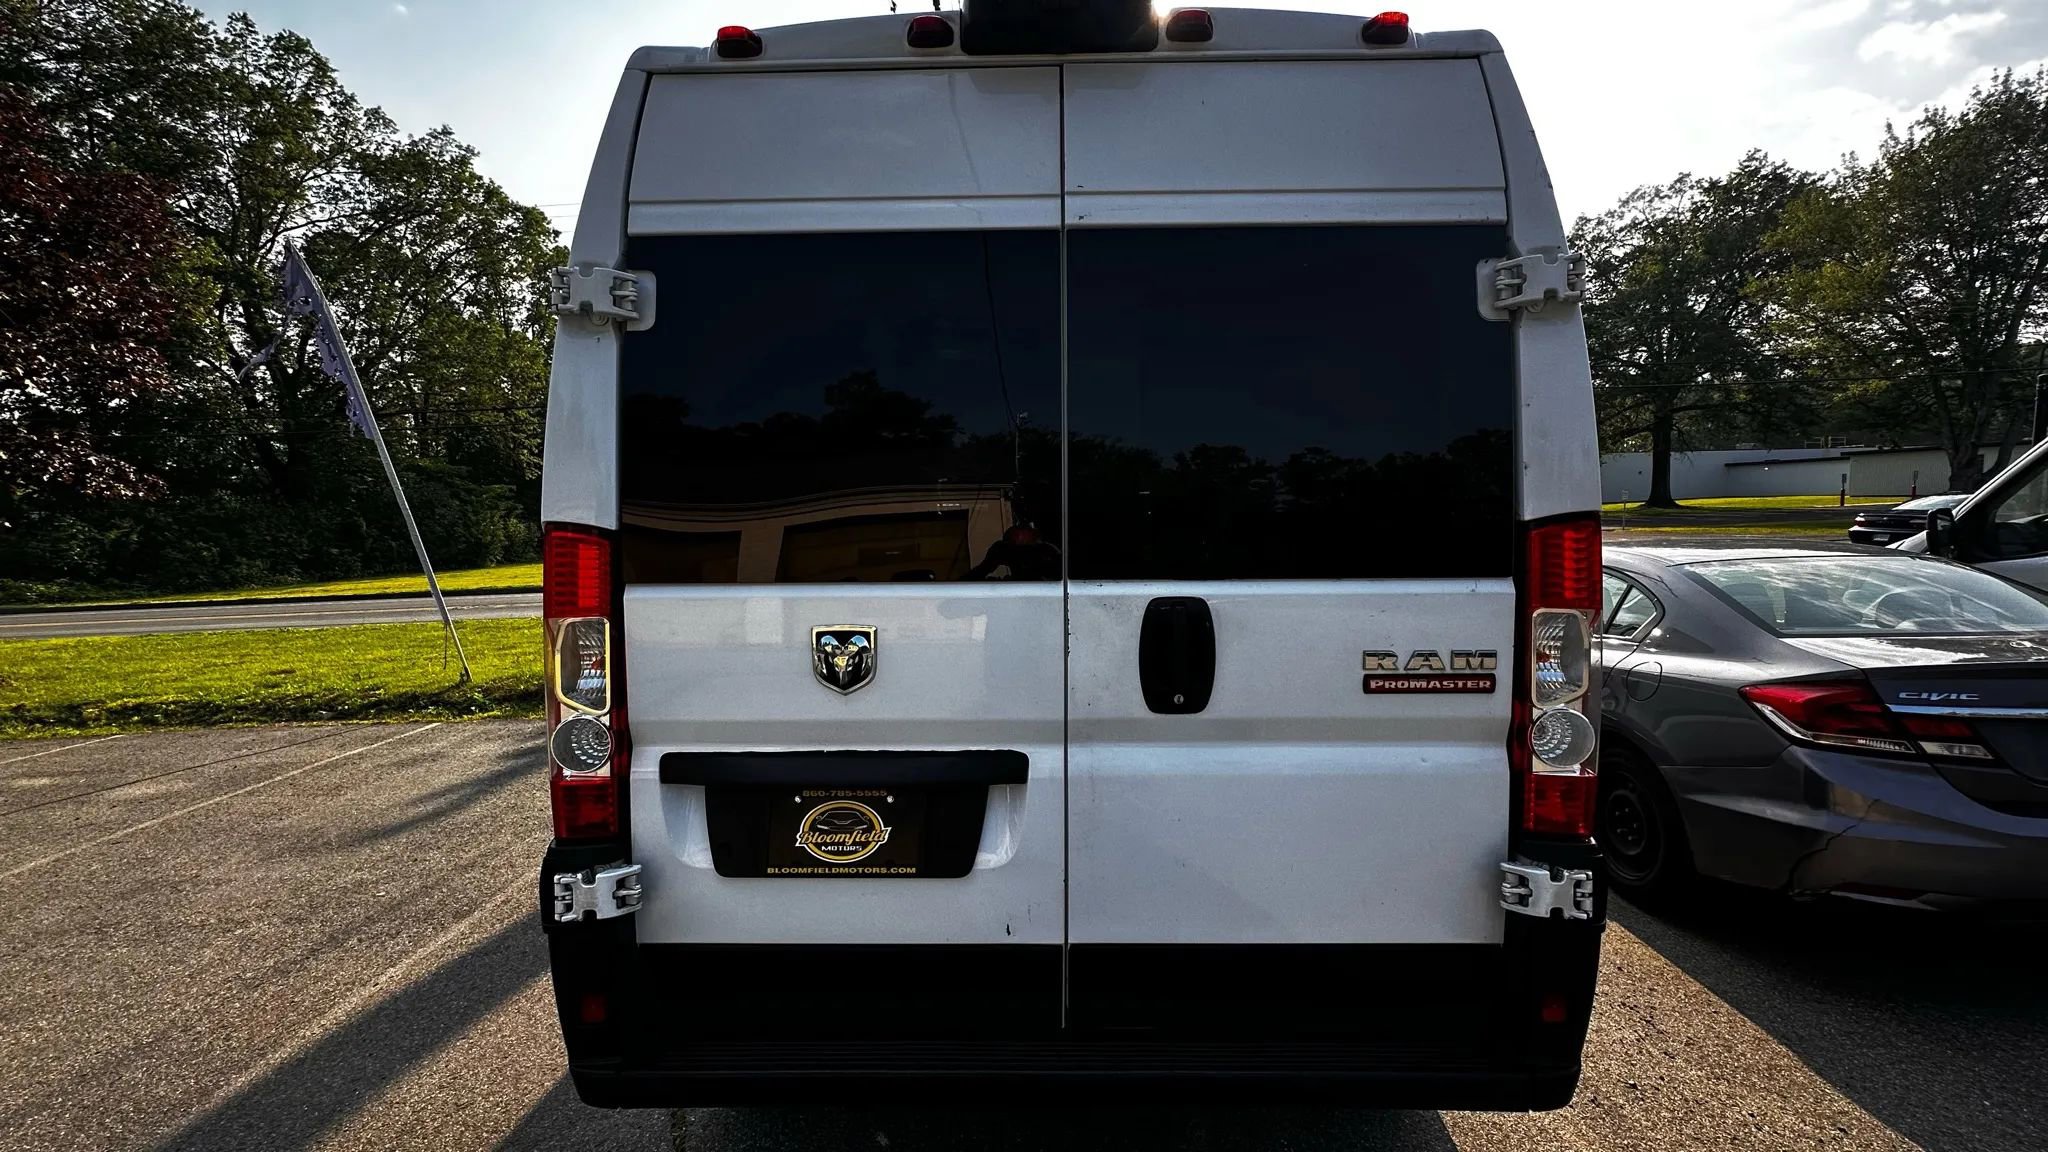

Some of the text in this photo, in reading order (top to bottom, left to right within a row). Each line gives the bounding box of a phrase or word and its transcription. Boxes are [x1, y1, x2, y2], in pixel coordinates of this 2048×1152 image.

[1363, 650, 1497, 671] RAM
[1369, 679, 1491, 689] PROMASTER
[1898, 691, 1980, 701] CIVIC
[800, 829, 886, 845] Bloomfield
